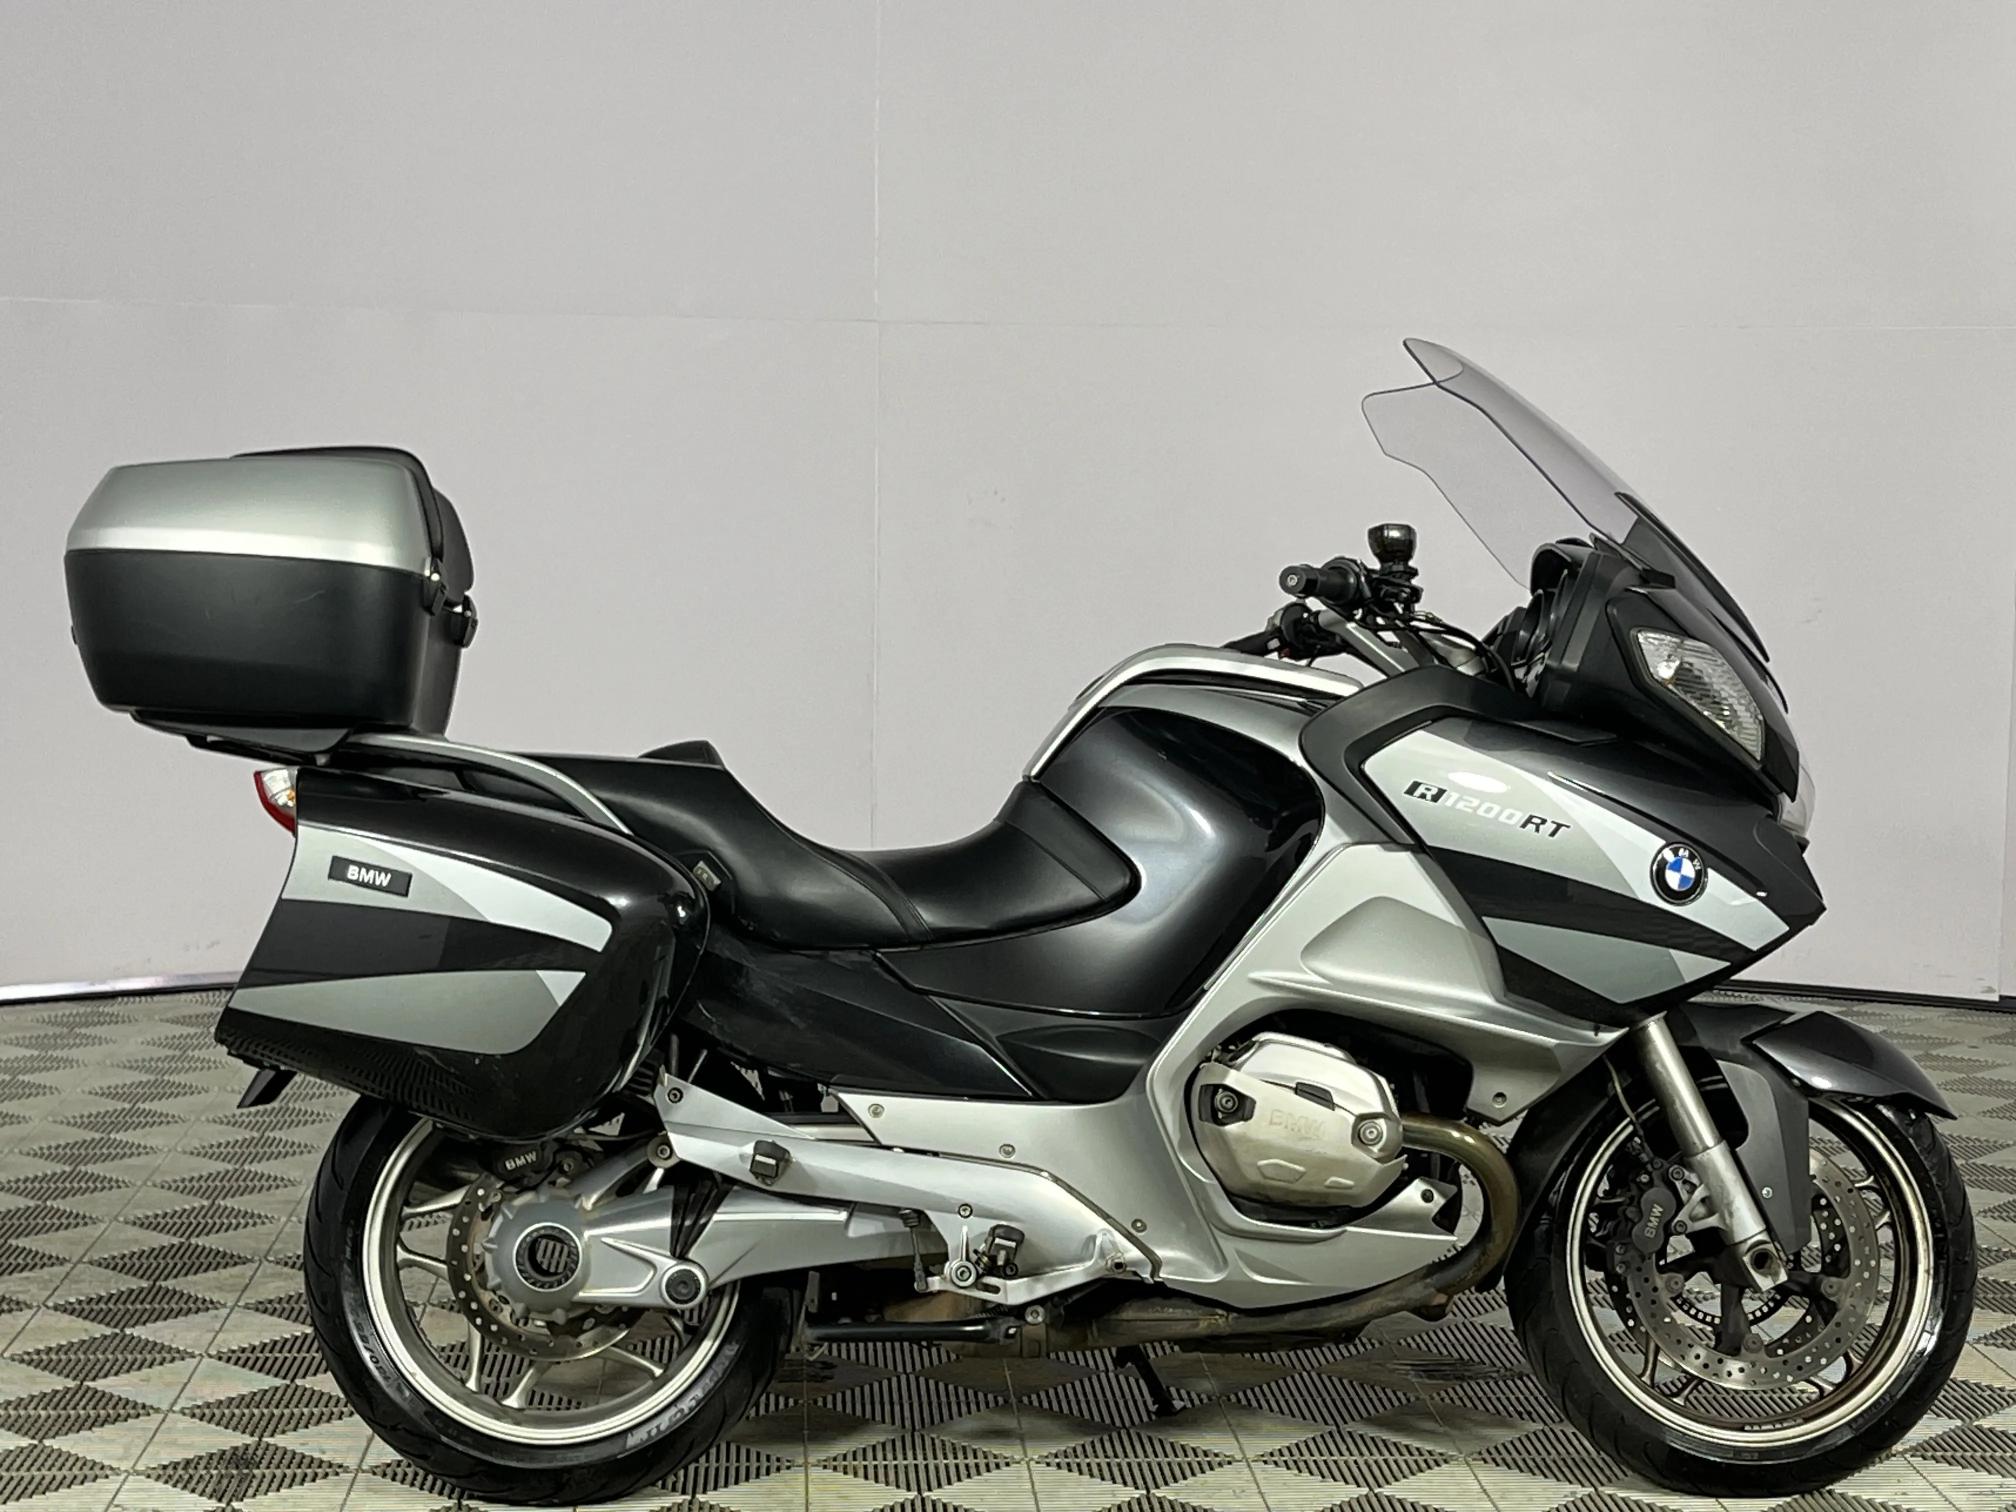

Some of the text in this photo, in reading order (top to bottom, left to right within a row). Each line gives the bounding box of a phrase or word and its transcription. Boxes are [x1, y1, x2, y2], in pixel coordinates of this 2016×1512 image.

[347, 864, 392, 887] BMW
[504, 1150, 537, 1171] BMW
[1644, 1203, 1664, 1239] BMW
